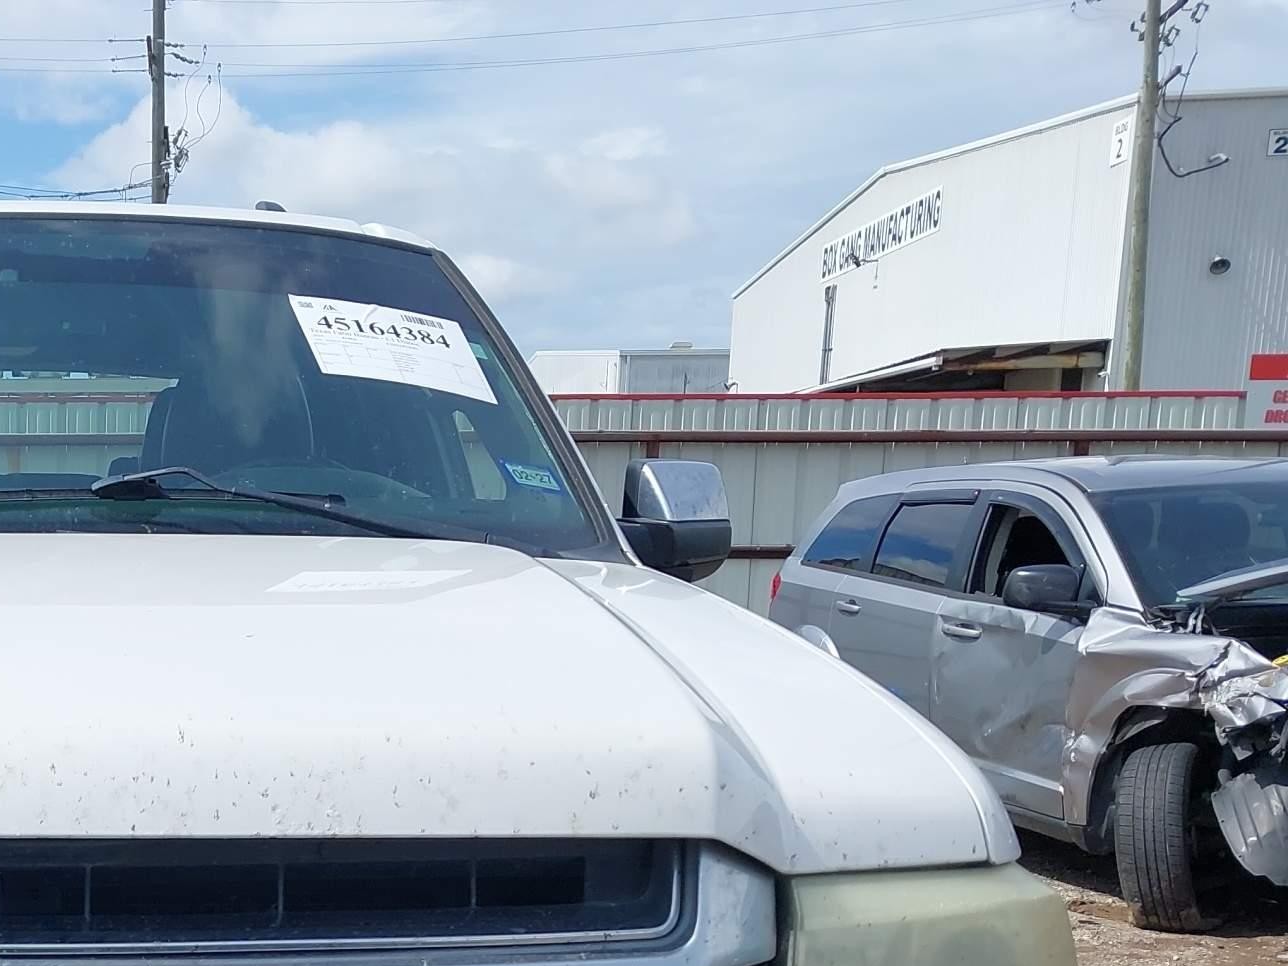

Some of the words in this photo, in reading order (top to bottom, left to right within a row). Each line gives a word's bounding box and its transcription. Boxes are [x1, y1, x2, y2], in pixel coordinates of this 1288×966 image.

[1116, 138, 1123, 158] 2
[822, 241, 838, 279] BOX
[863, 190, 941, 259] MANUFACTURING
[317, 316, 451, 348] 45164384
